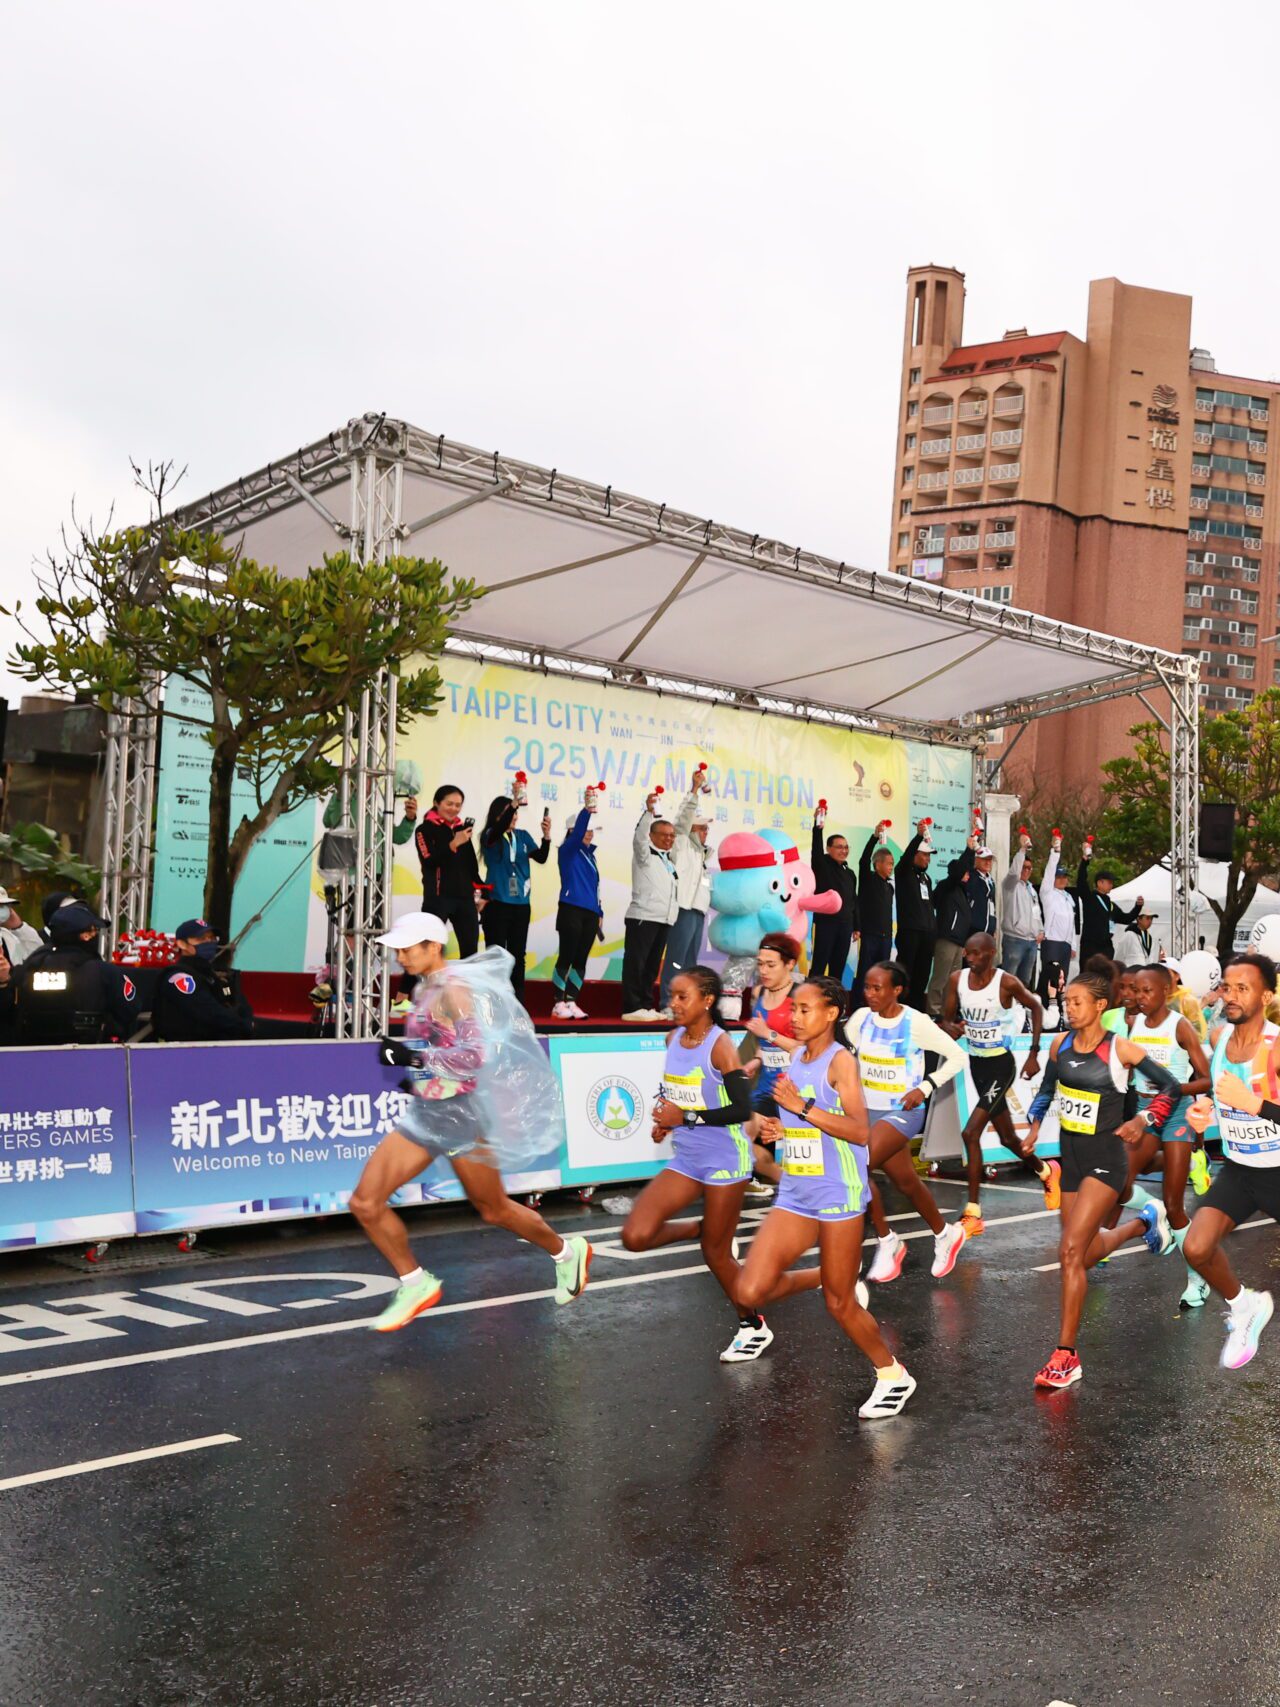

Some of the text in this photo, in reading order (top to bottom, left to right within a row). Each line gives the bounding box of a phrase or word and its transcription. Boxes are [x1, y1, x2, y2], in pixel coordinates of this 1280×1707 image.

[446, 682, 603, 733] TAIPEI CITY
[610, 726, 632, 739] WAN
[503, 736, 587, 779] 2025
[665, 757, 814, 809] MRATHON
[967, 1028, 997, 1040] 10127
[767, 1055, 785, 1065] YEH
[867, 1067, 896, 1080] AMID
[171, 1091, 411, 1150] 新北歡迎您
[49, 1127, 114, 1147] GAMES
[1228, 1121, 1278, 1140] HUSEN
[173, 1154, 262, 1174] Welcome
[267, 1149, 285, 1166] to
[291, 1146, 329, 1164] New
